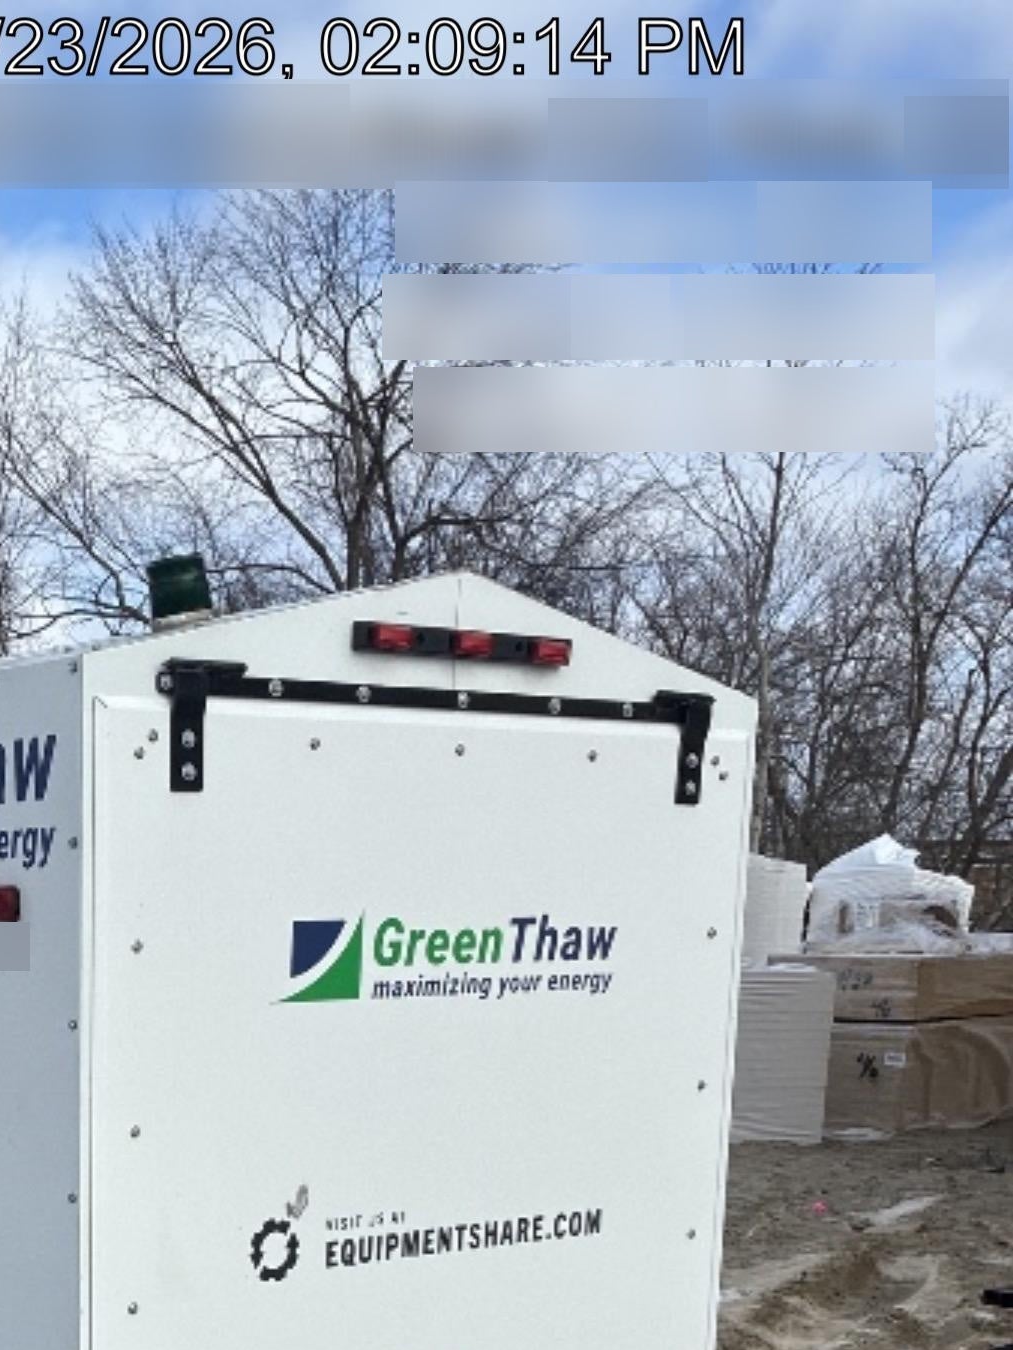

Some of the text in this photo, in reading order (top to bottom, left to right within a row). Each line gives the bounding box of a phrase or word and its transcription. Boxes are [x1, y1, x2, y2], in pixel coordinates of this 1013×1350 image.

[370, 971, 613, 1000] maximizing your energy
[325, 1214, 363, 1231] VISIT
[324, 1207, 604, 1270] EQUIPMENTSHARE.COM
